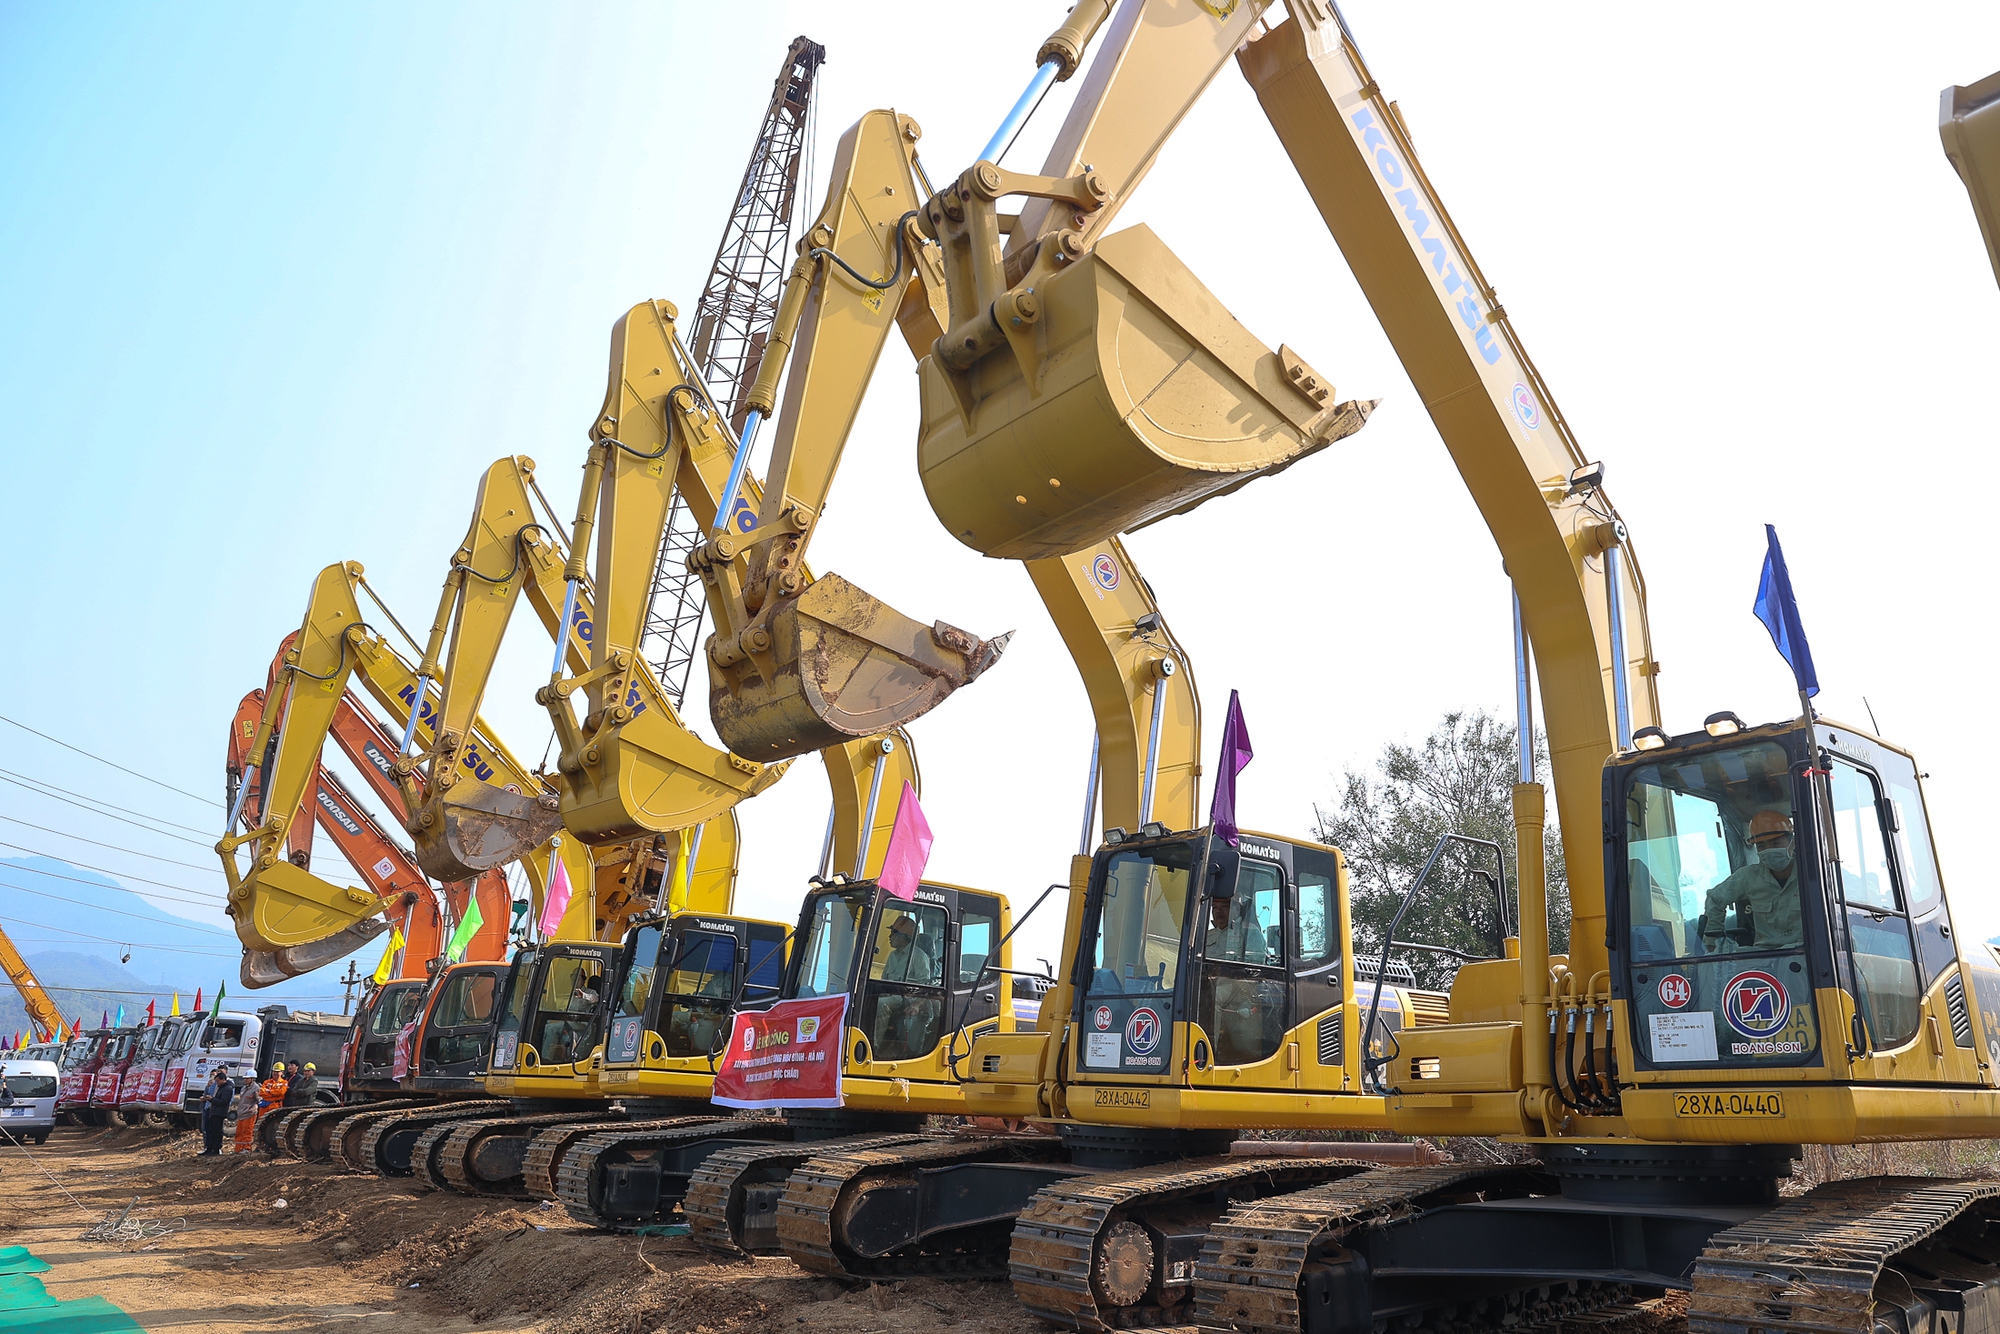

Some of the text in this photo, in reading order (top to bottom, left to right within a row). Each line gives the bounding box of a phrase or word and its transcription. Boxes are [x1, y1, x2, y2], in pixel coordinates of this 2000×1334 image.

[1351, 106, 1502, 366] KOMATSU
[317, 791, 359, 834] DOOSAN
[1240, 842, 1280, 860] KOMATSU
[914, 890, 946, 903] OMATSU
[700, 921, 735, 933] KOMATSU
[569, 948, 602, 957] KOMATSU
[1661, 979, 1688, 1002] 64
[1096, 1010, 1111, 1026] 62
[1732, 1041, 1802, 1054] HOANG SON
